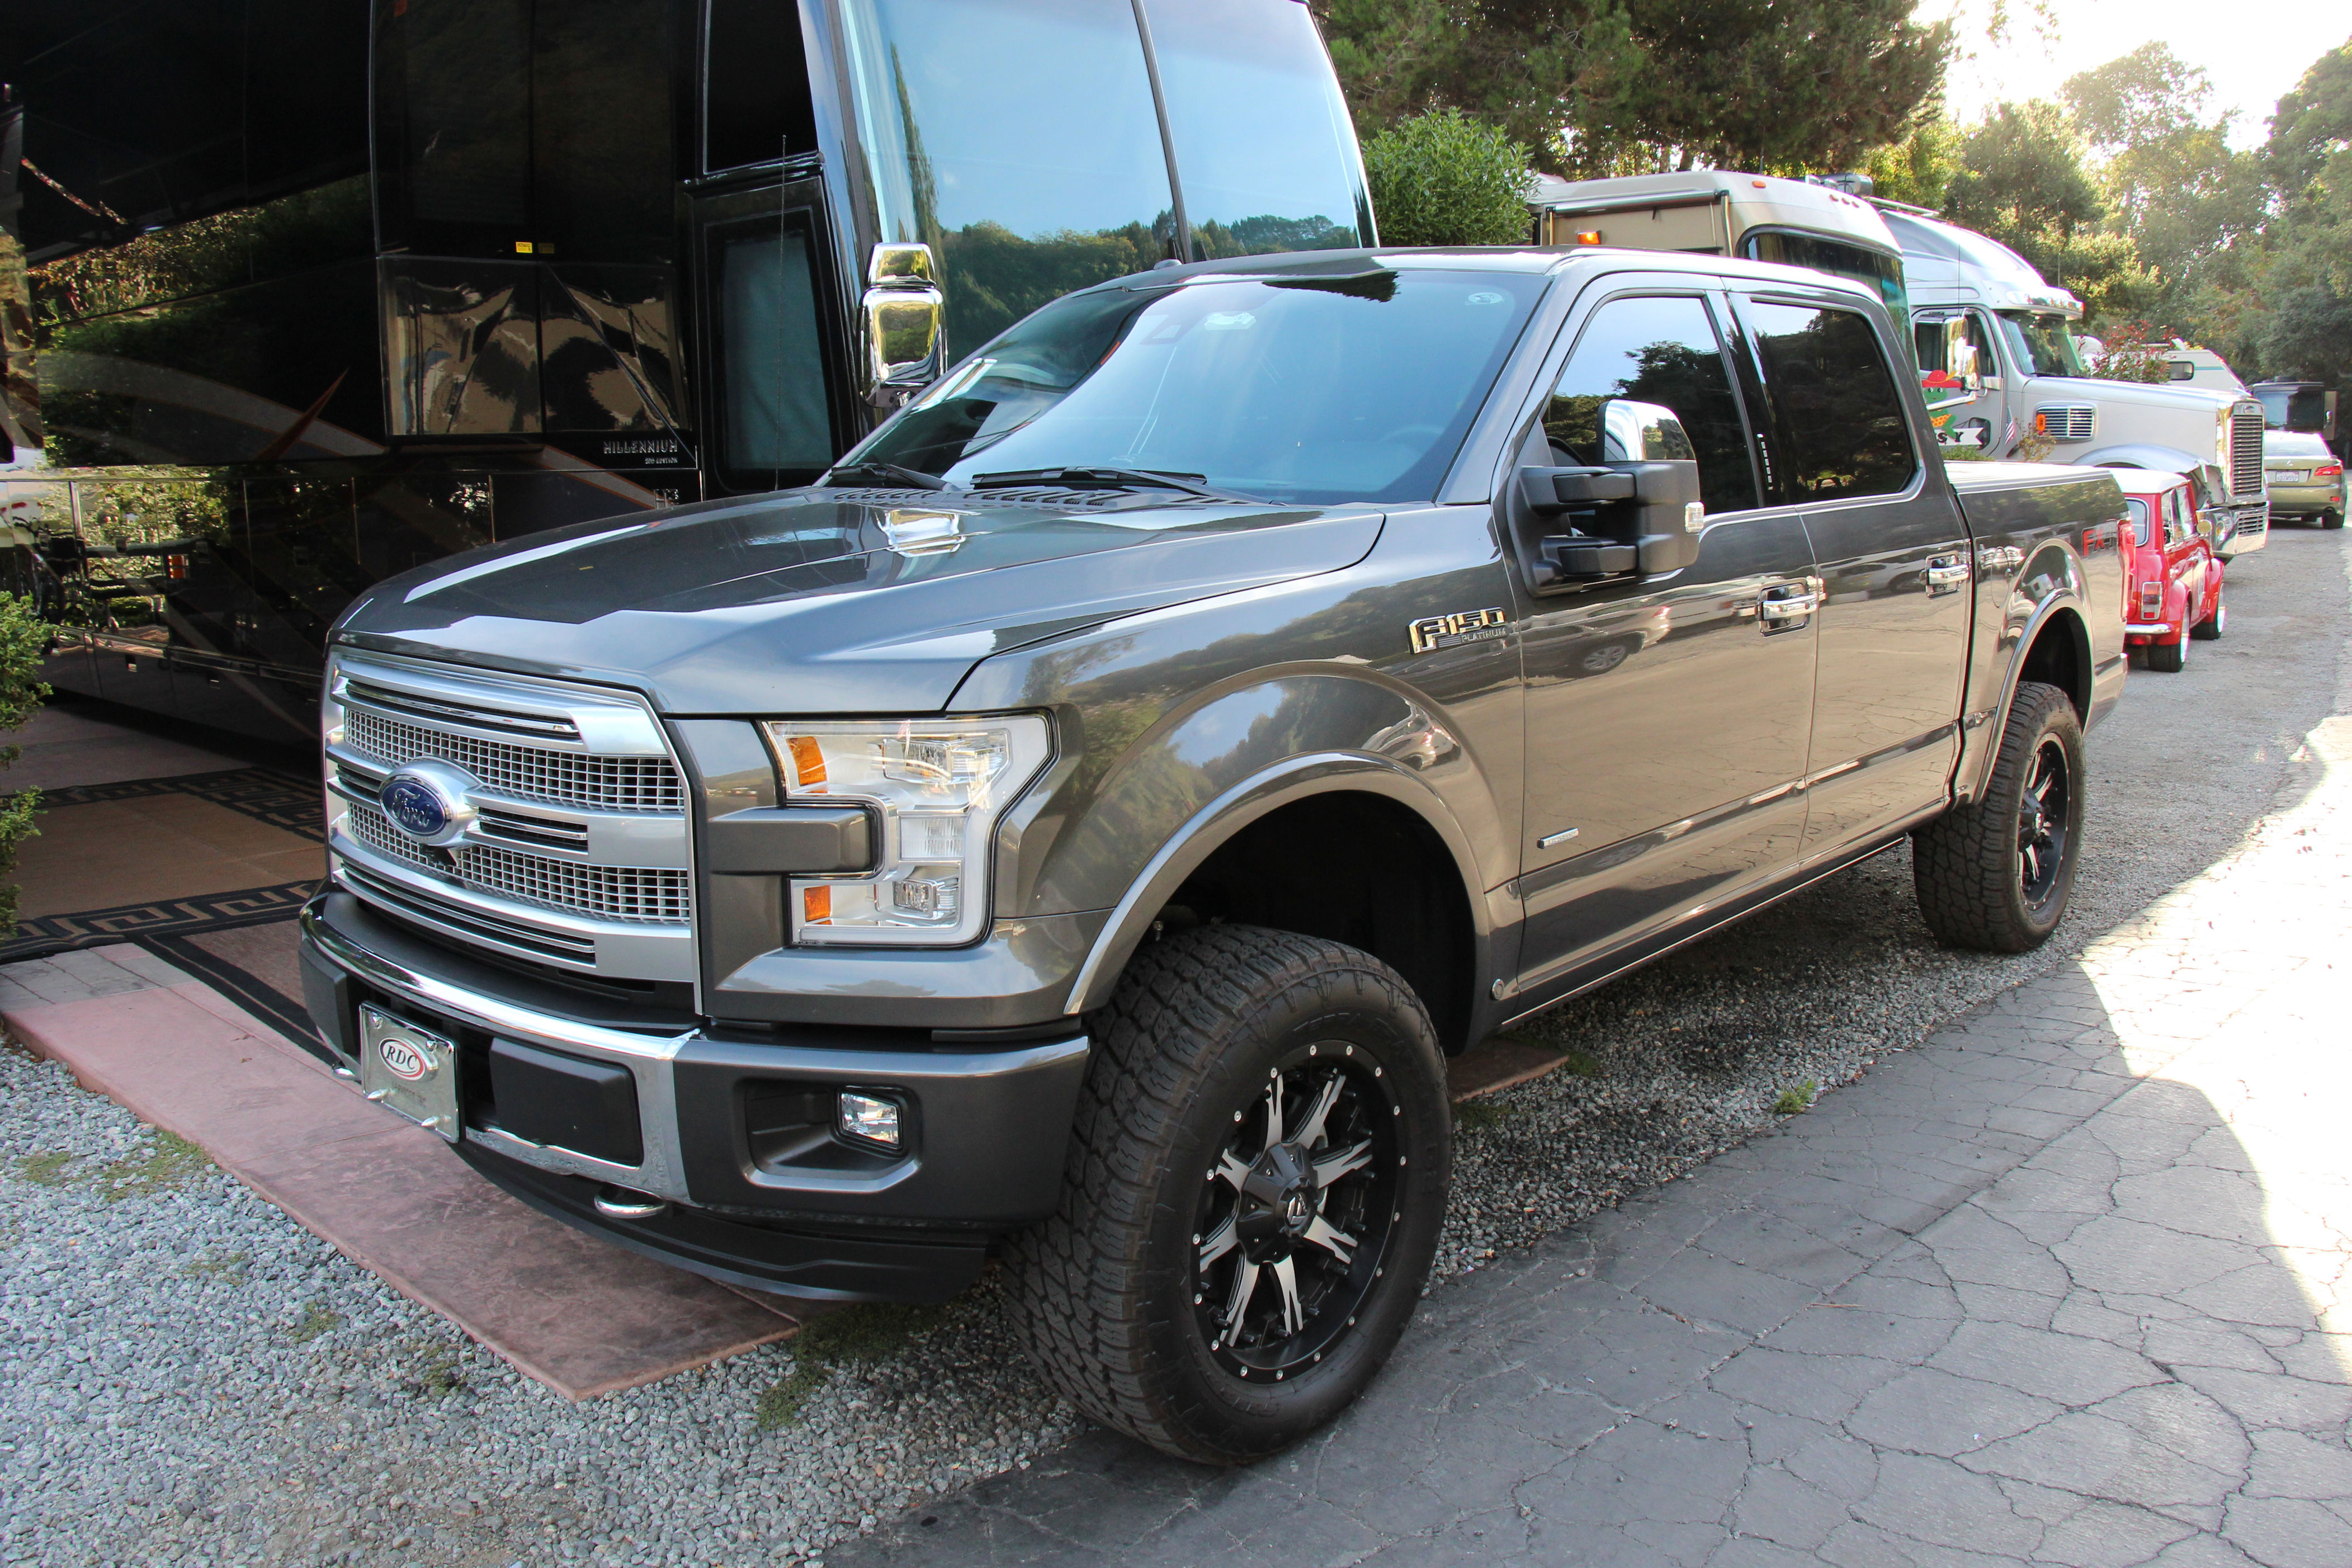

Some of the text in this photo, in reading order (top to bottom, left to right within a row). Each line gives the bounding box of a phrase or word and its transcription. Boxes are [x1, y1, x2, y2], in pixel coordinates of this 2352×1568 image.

[603, 439, 678, 454] MILLENNIUM
[1461, 627, 1506, 643] PLATINUM
[392, 787, 430, 828] Ford
[386, 1045, 417, 1070] RDC
